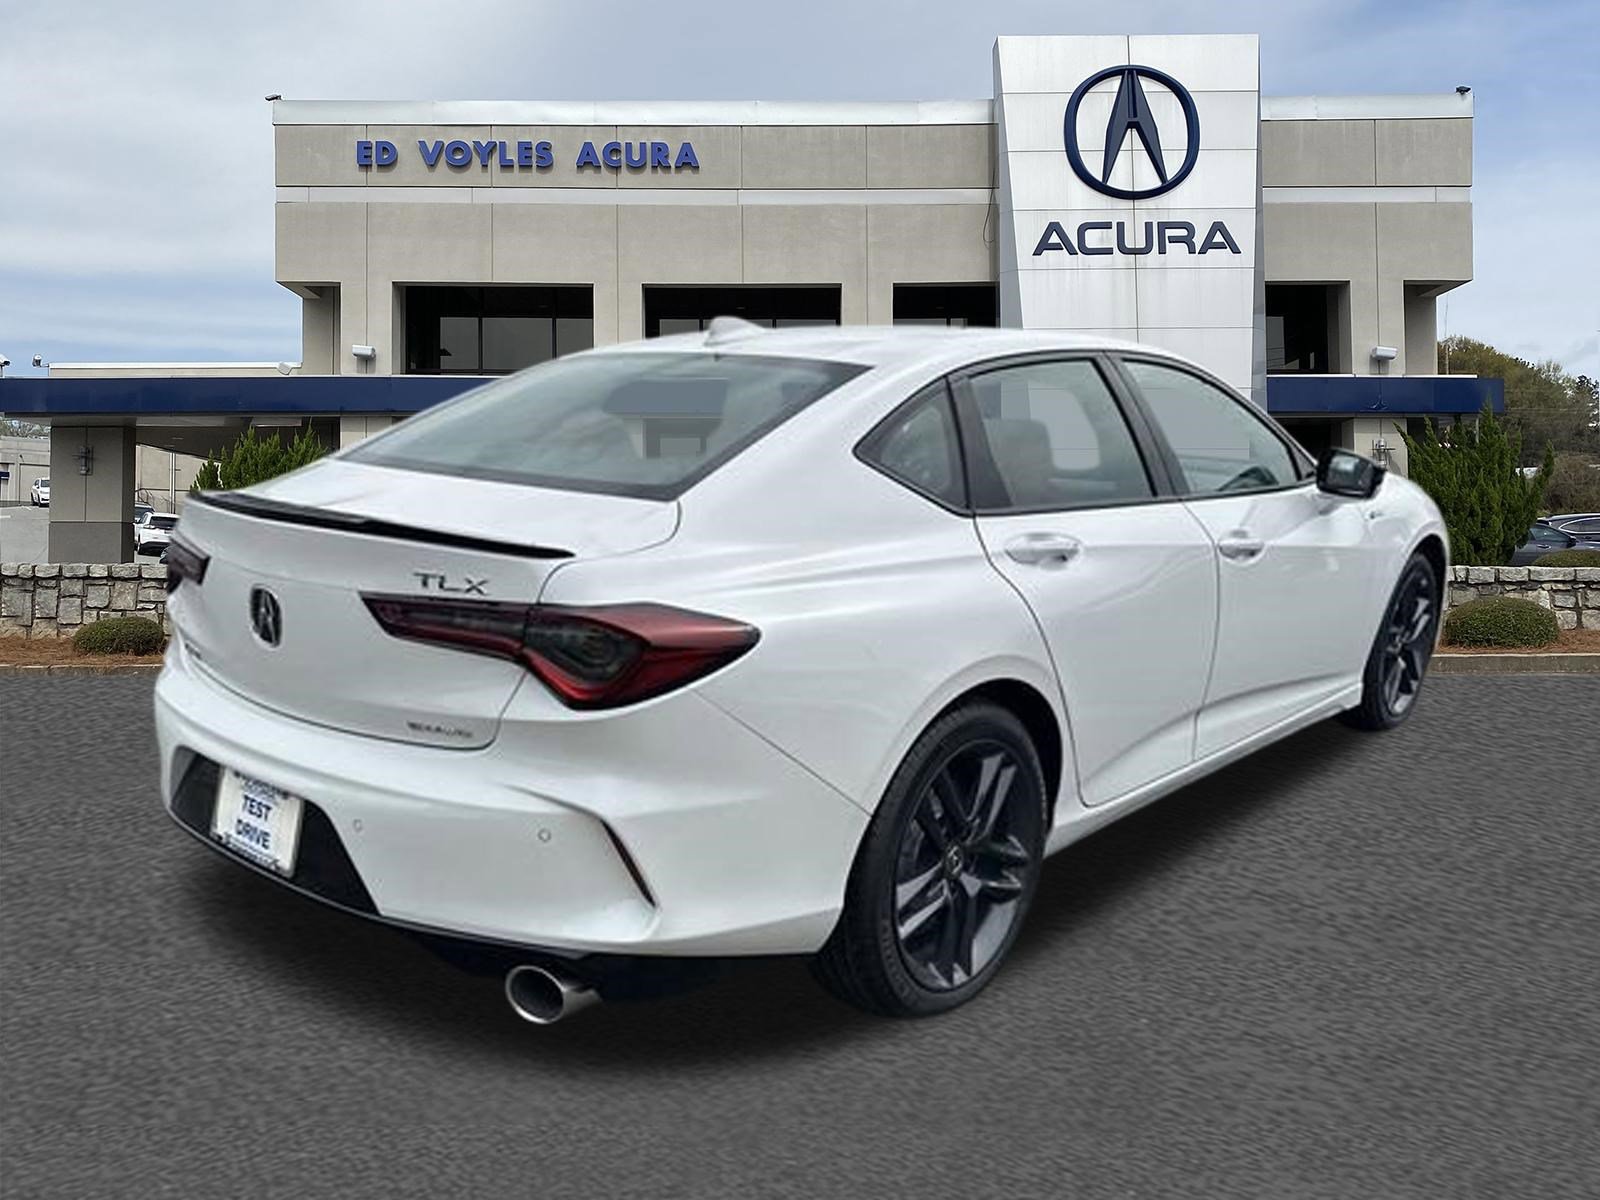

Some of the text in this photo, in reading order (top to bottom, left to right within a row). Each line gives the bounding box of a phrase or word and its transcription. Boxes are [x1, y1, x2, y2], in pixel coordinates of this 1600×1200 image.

[356, 140, 700, 168] ED VOYLES ACURA
[1032, 221, 1242, 256] ACURA
[413, 572, 491, 596] TLX
[242, 794, 272, 822] TEST
[235, 818, 271, 850] DRIVE
